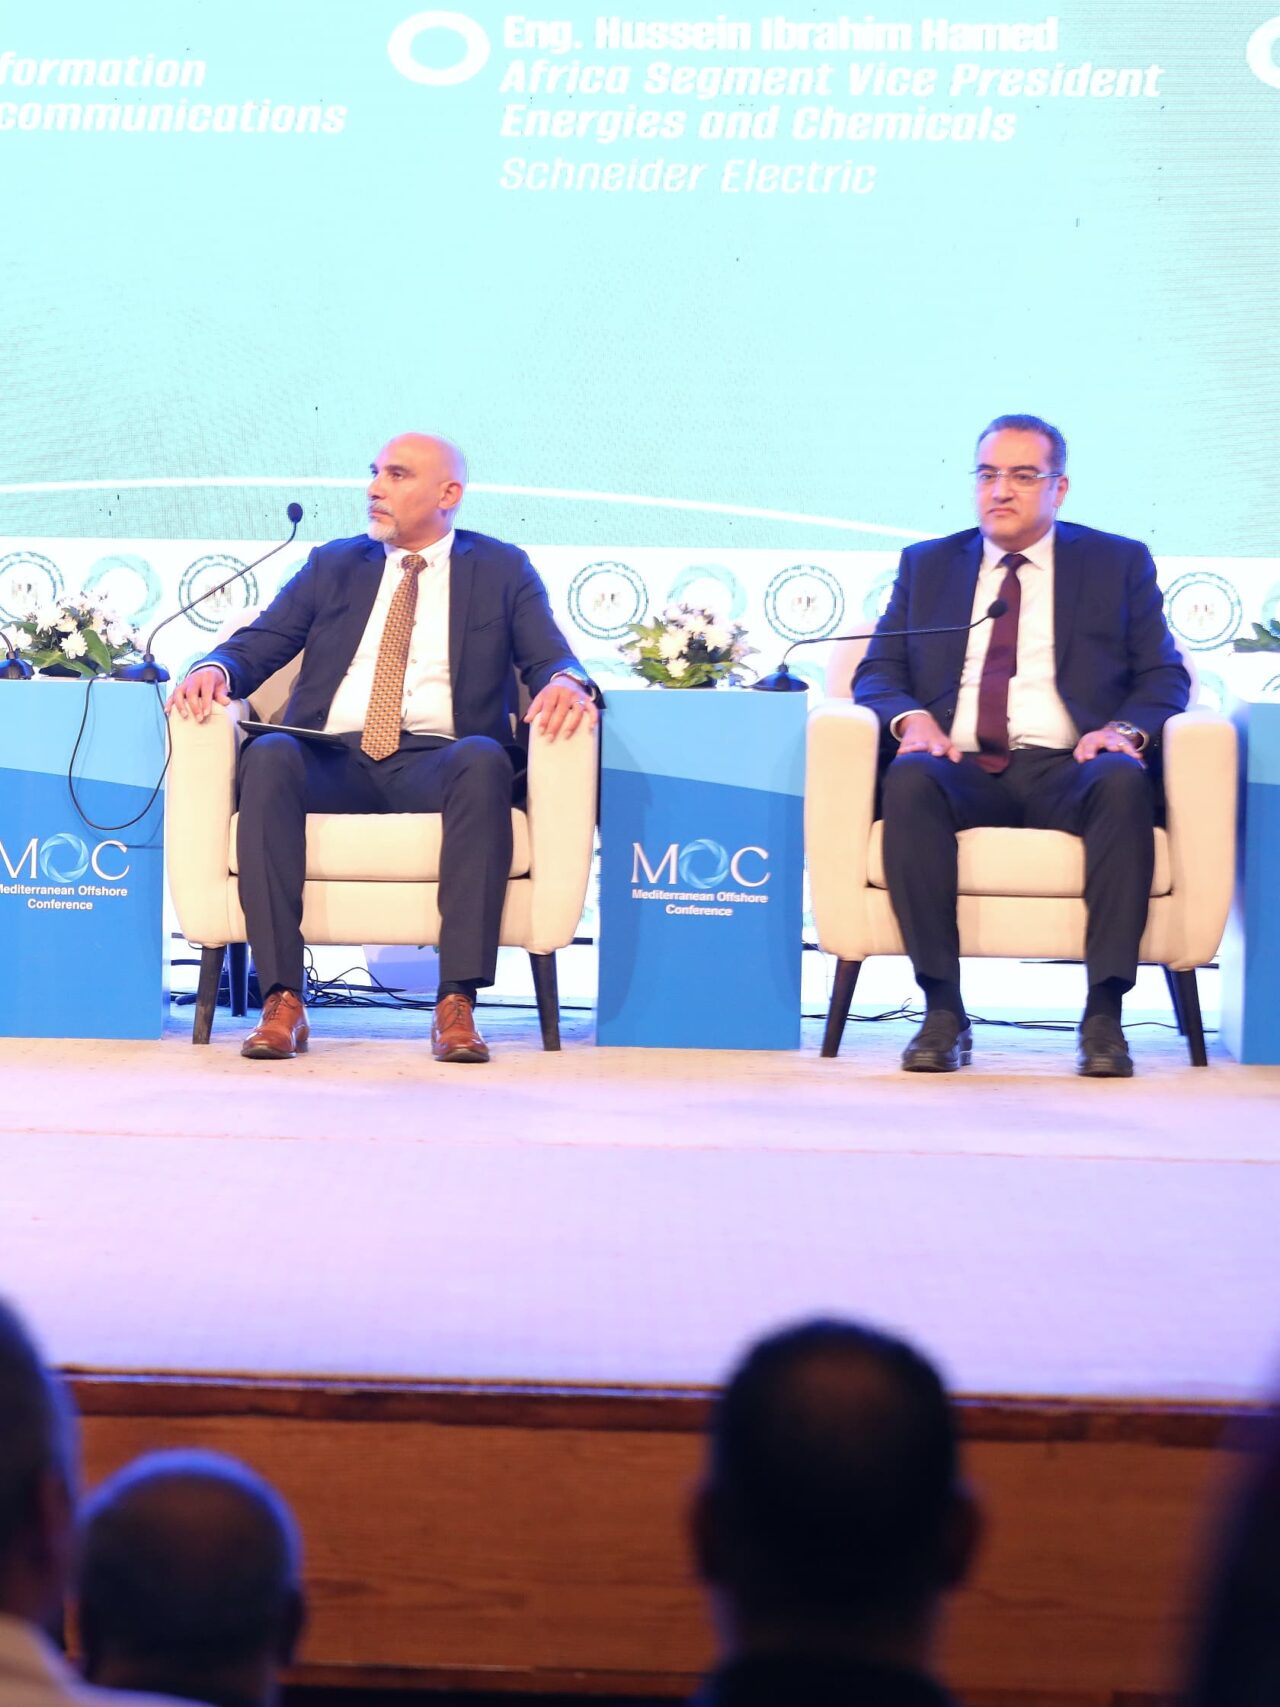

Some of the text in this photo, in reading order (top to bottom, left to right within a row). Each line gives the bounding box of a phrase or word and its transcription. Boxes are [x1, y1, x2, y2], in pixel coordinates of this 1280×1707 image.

[503, 15, 1060, 54] Eng. Hussein Ibrahim Hamed
[499, 60, 1165, 100] Africa Segment Vice President
[500, 103, 1018, 144] Energies and Chemicals
[499, 157, 878, 193] Schneider Electric
[631, 839, 770, 889] MOC
[27, 898, 93, 909] Conference
[78, 885, 128, 896] Offshore
[632, 889, 768, 903] Mediterranean Offshore
[665, 904, 733, 916] Conference
